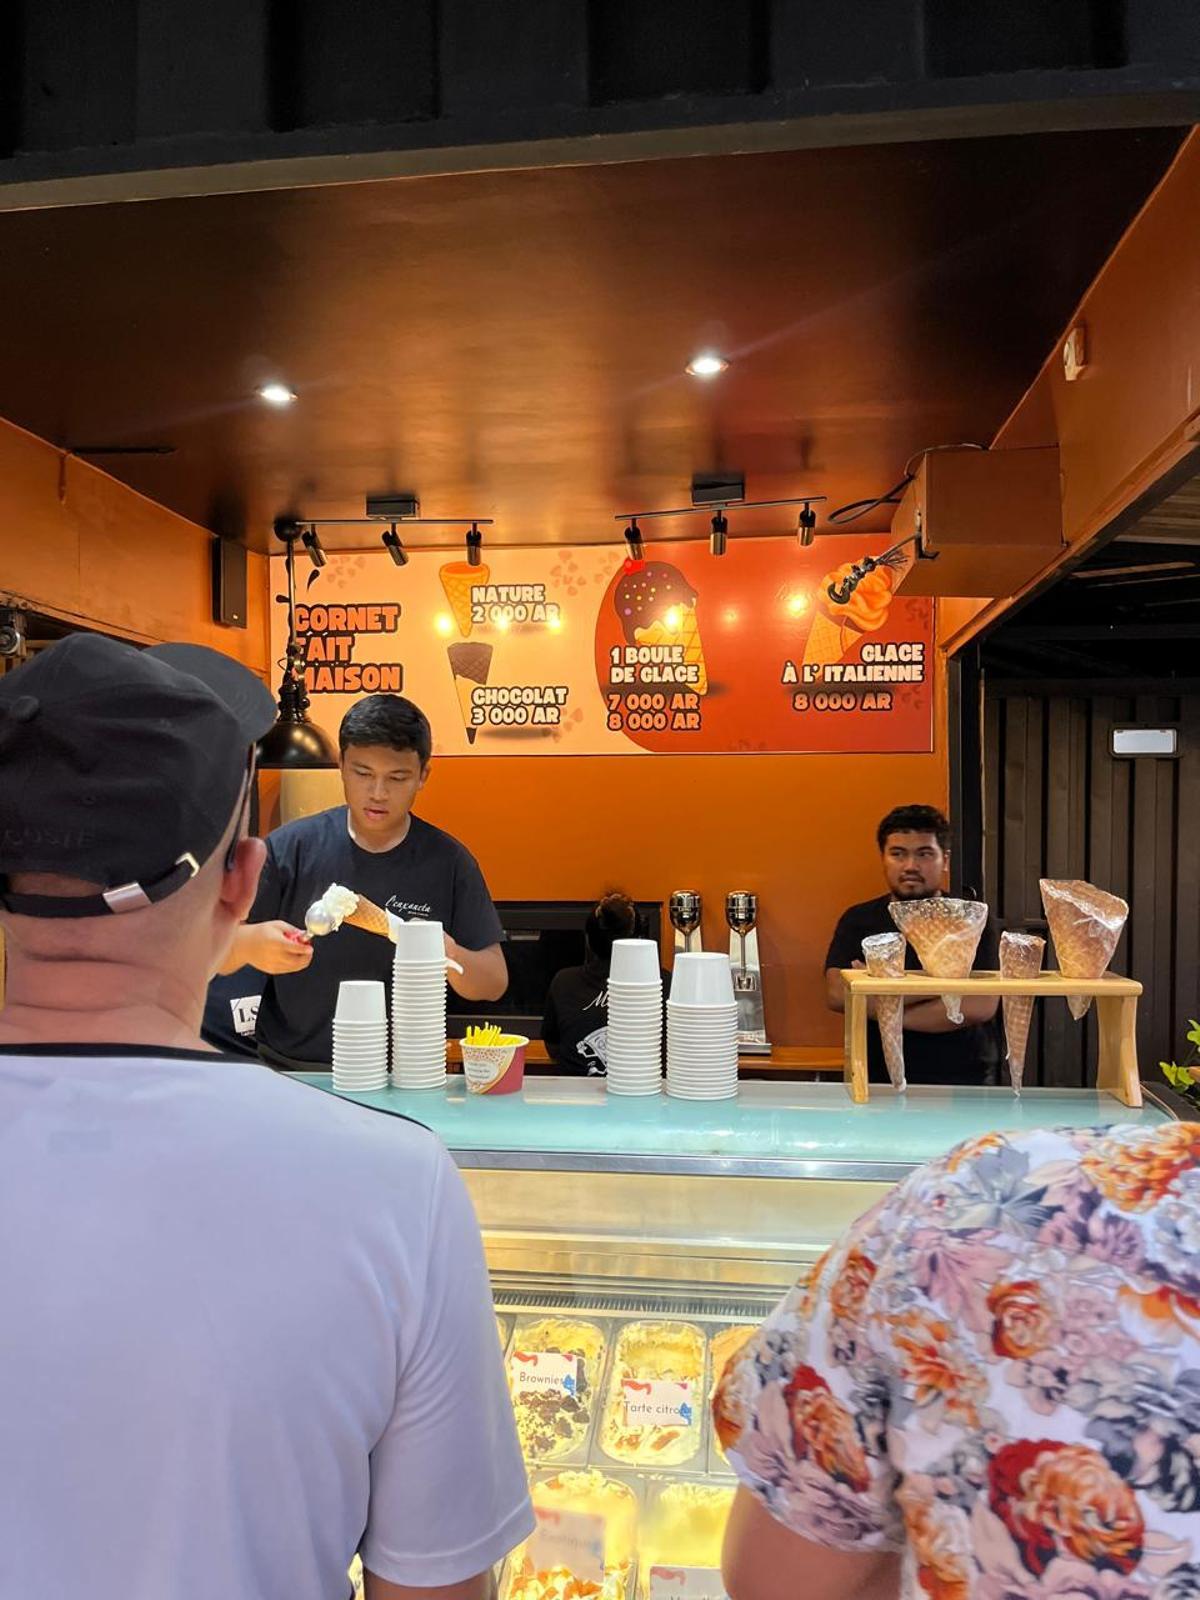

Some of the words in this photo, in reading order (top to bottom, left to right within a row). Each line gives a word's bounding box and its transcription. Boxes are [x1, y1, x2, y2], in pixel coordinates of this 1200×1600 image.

[471, 584, 546, 604] NATURE
[293, 603, 401, 633] CORNET
[471, 604, 485, 623] 2
[489, 604, 529, 622] 000
[531, 602, 561, 622] AR
[610, 645, 621, 665] 1
[625, 644, 685, 664] BOULE
[860, 643, 925, 664] GLACE
[610, 664, 638, 684] DE
[640, 663, 700, 684] GLACE
[781, 660, 798, 684] À
[823, 664, 925, 683] ITALIENNE
[471, 686, 569, 706] CHOCOLAT
[607, 693, 623, 711] 7
[626, 693, 666, 711] 000
[670, 692, 701, 711] AR
[792, 692, 810, 711] 8
[814, 693, 856, 711] 000
[860, 692, 893, 711] AR
[471, 707, 486, 725] 3
[490, 707, 529, 725] 000
[532, 706, 561, 725] AR
[607, 711, 624, 730] 8
[626, 712, 668, 730] 000
[671, 711, 702, 730] AR
[623, 1400, 653, 1414] Tarte
[655, 1403, 681, 1415] citro
